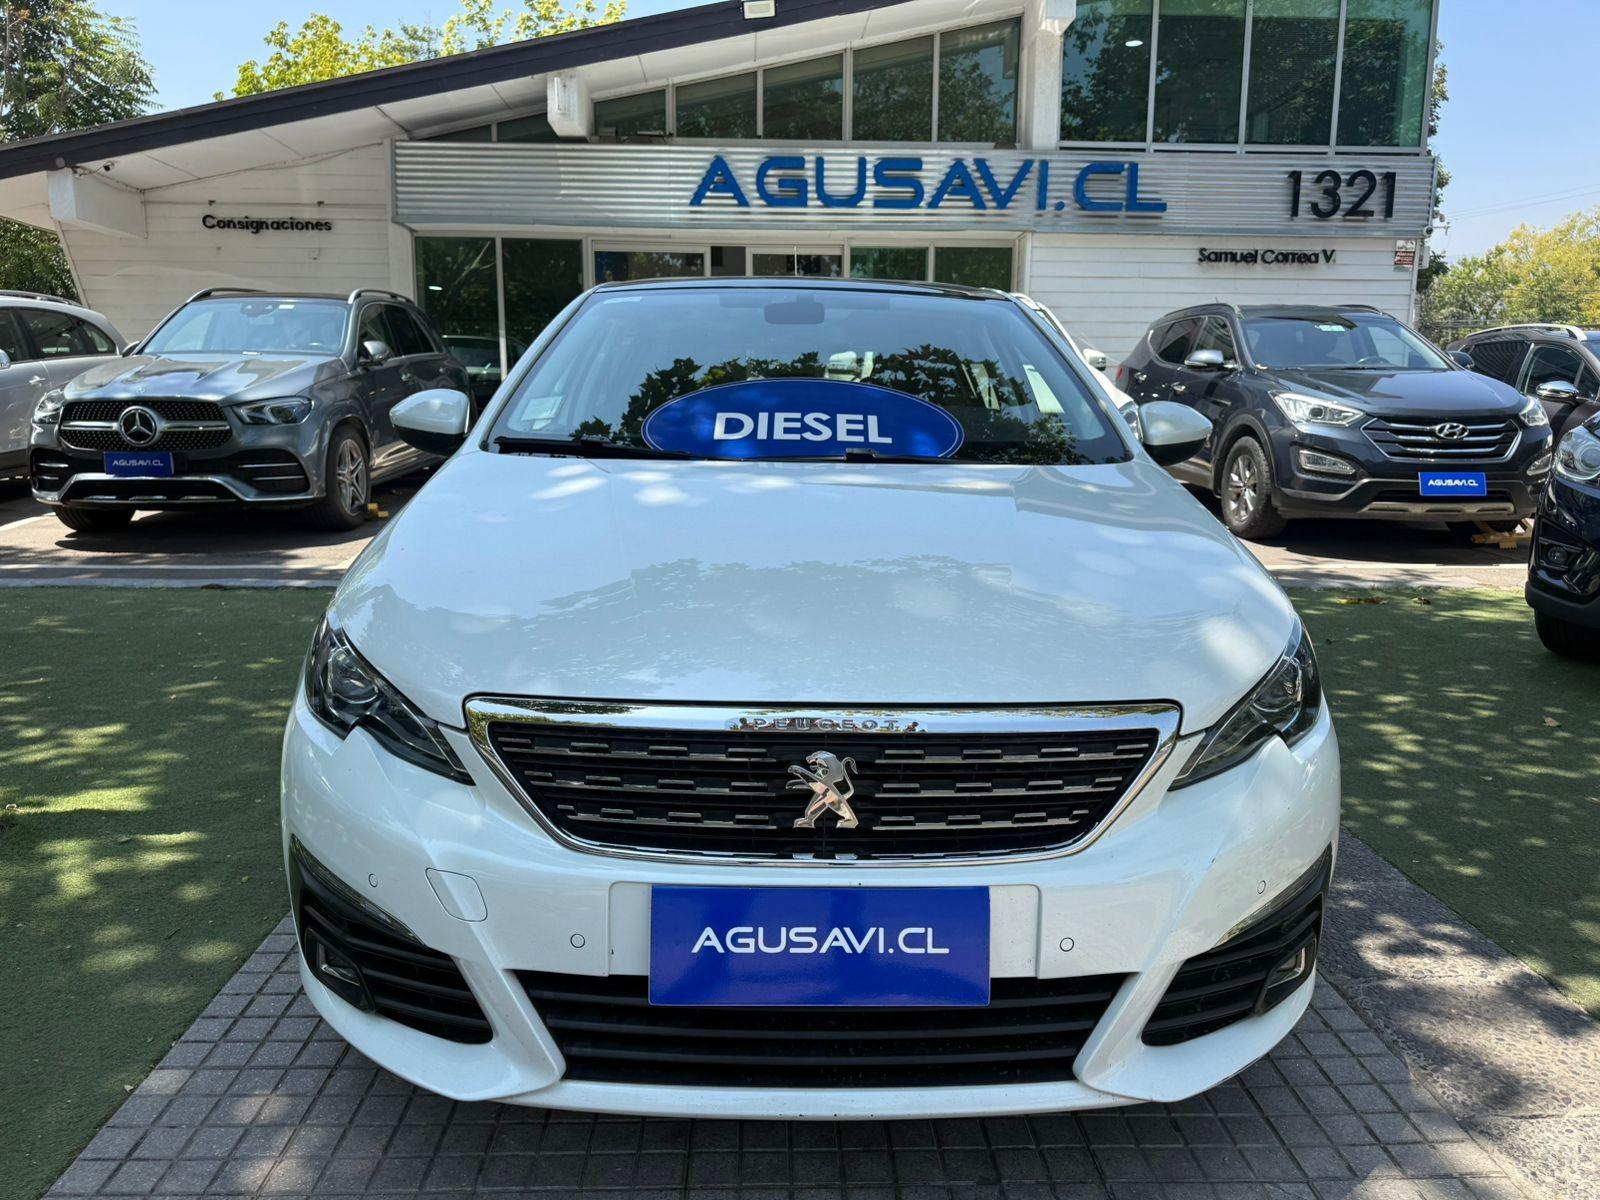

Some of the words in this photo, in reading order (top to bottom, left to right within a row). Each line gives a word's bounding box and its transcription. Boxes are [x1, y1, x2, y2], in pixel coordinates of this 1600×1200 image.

[689, 154, 1168, 213] AGUSAVI.CL
[1286, 169, 1397, 219] 1321
[202, 214, 332, 234] Consignaciones
[1198, 247, 1258, 264] Samuel
[1261, 249, 1319, 264] Correa
[713, 411, 893, 444] DIESEL
[112, 459, 164, 467] AGUSAVI.CL
[1428, 479, 1479, 487] AGUSAVI.CL
[752, 718, 900, 731] PEUGEOT
[691, 926, 950, 954] AGUSAVI.CL
